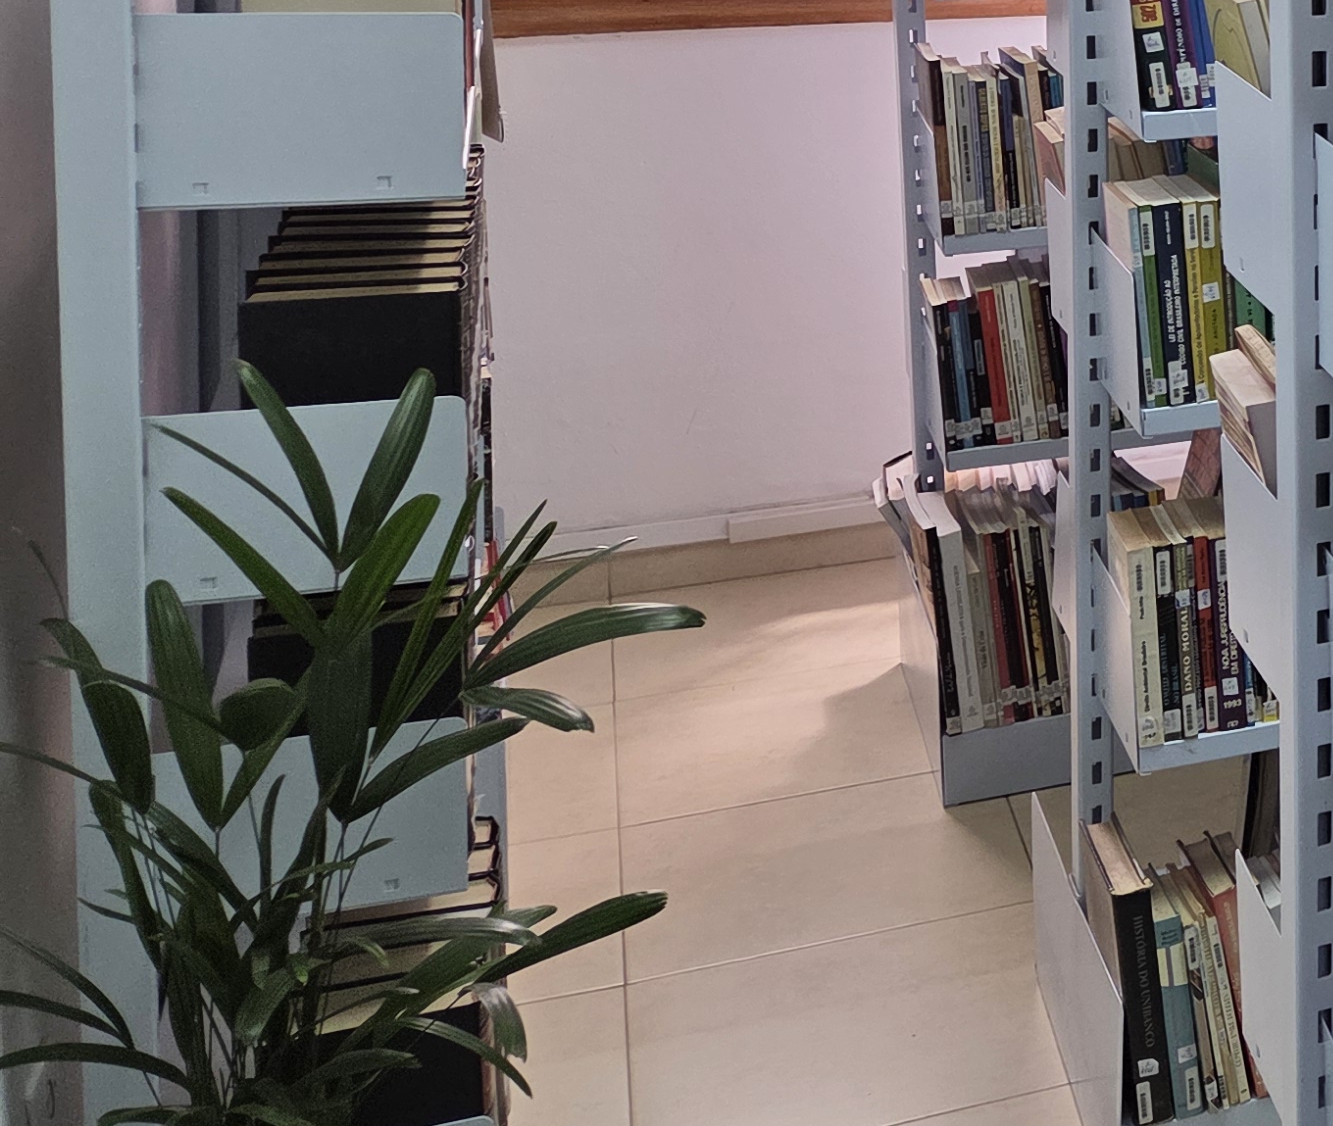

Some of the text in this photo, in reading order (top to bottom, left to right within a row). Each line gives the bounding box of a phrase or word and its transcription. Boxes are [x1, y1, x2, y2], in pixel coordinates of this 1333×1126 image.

[1140, 4, 1158, 23] 502
[1179, 607, 1193, 692] DANO MORAL
[1223, 698, 1242, 709] 1993
[1132, 914, 1156, 1049] HISTÓRIA DO UNIBANCO
